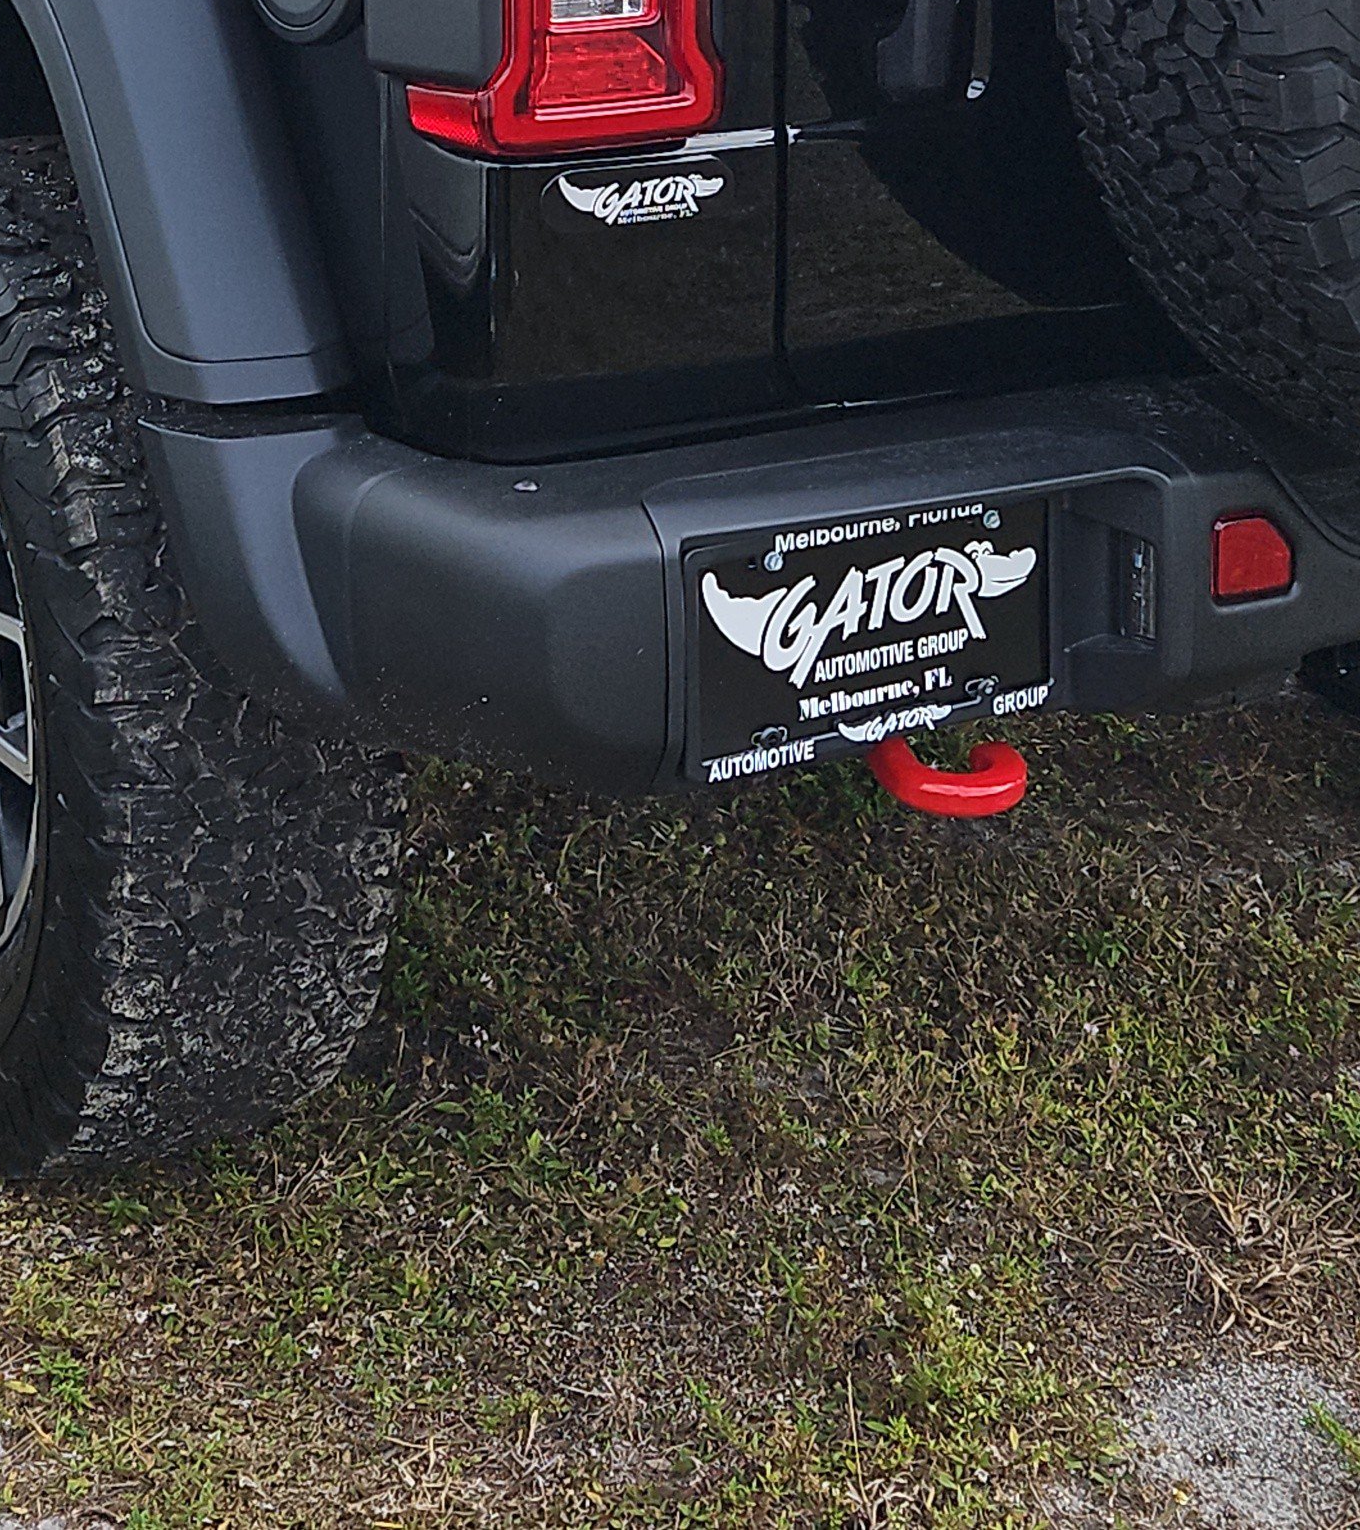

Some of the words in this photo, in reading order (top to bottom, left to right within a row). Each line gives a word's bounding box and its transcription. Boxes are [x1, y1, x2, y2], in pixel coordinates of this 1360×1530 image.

[594, 175, 698, 225] GATOR
[774, 516, 901, 553] Melbourne,
[763, 547, 986, 688] GATOR
[814, 640, 914, 682] AUTOMOTIVE
[917, 628, 968, 658] GROUP
[798, 678, 920, 721] Melbourne,
[924, 667, 953, 691] FL
[707, 738, 816, 784] AUTOMOTIVE
[866, 708, 936, 741] GATOR
[993, 685, 1048, 715] GROUP
